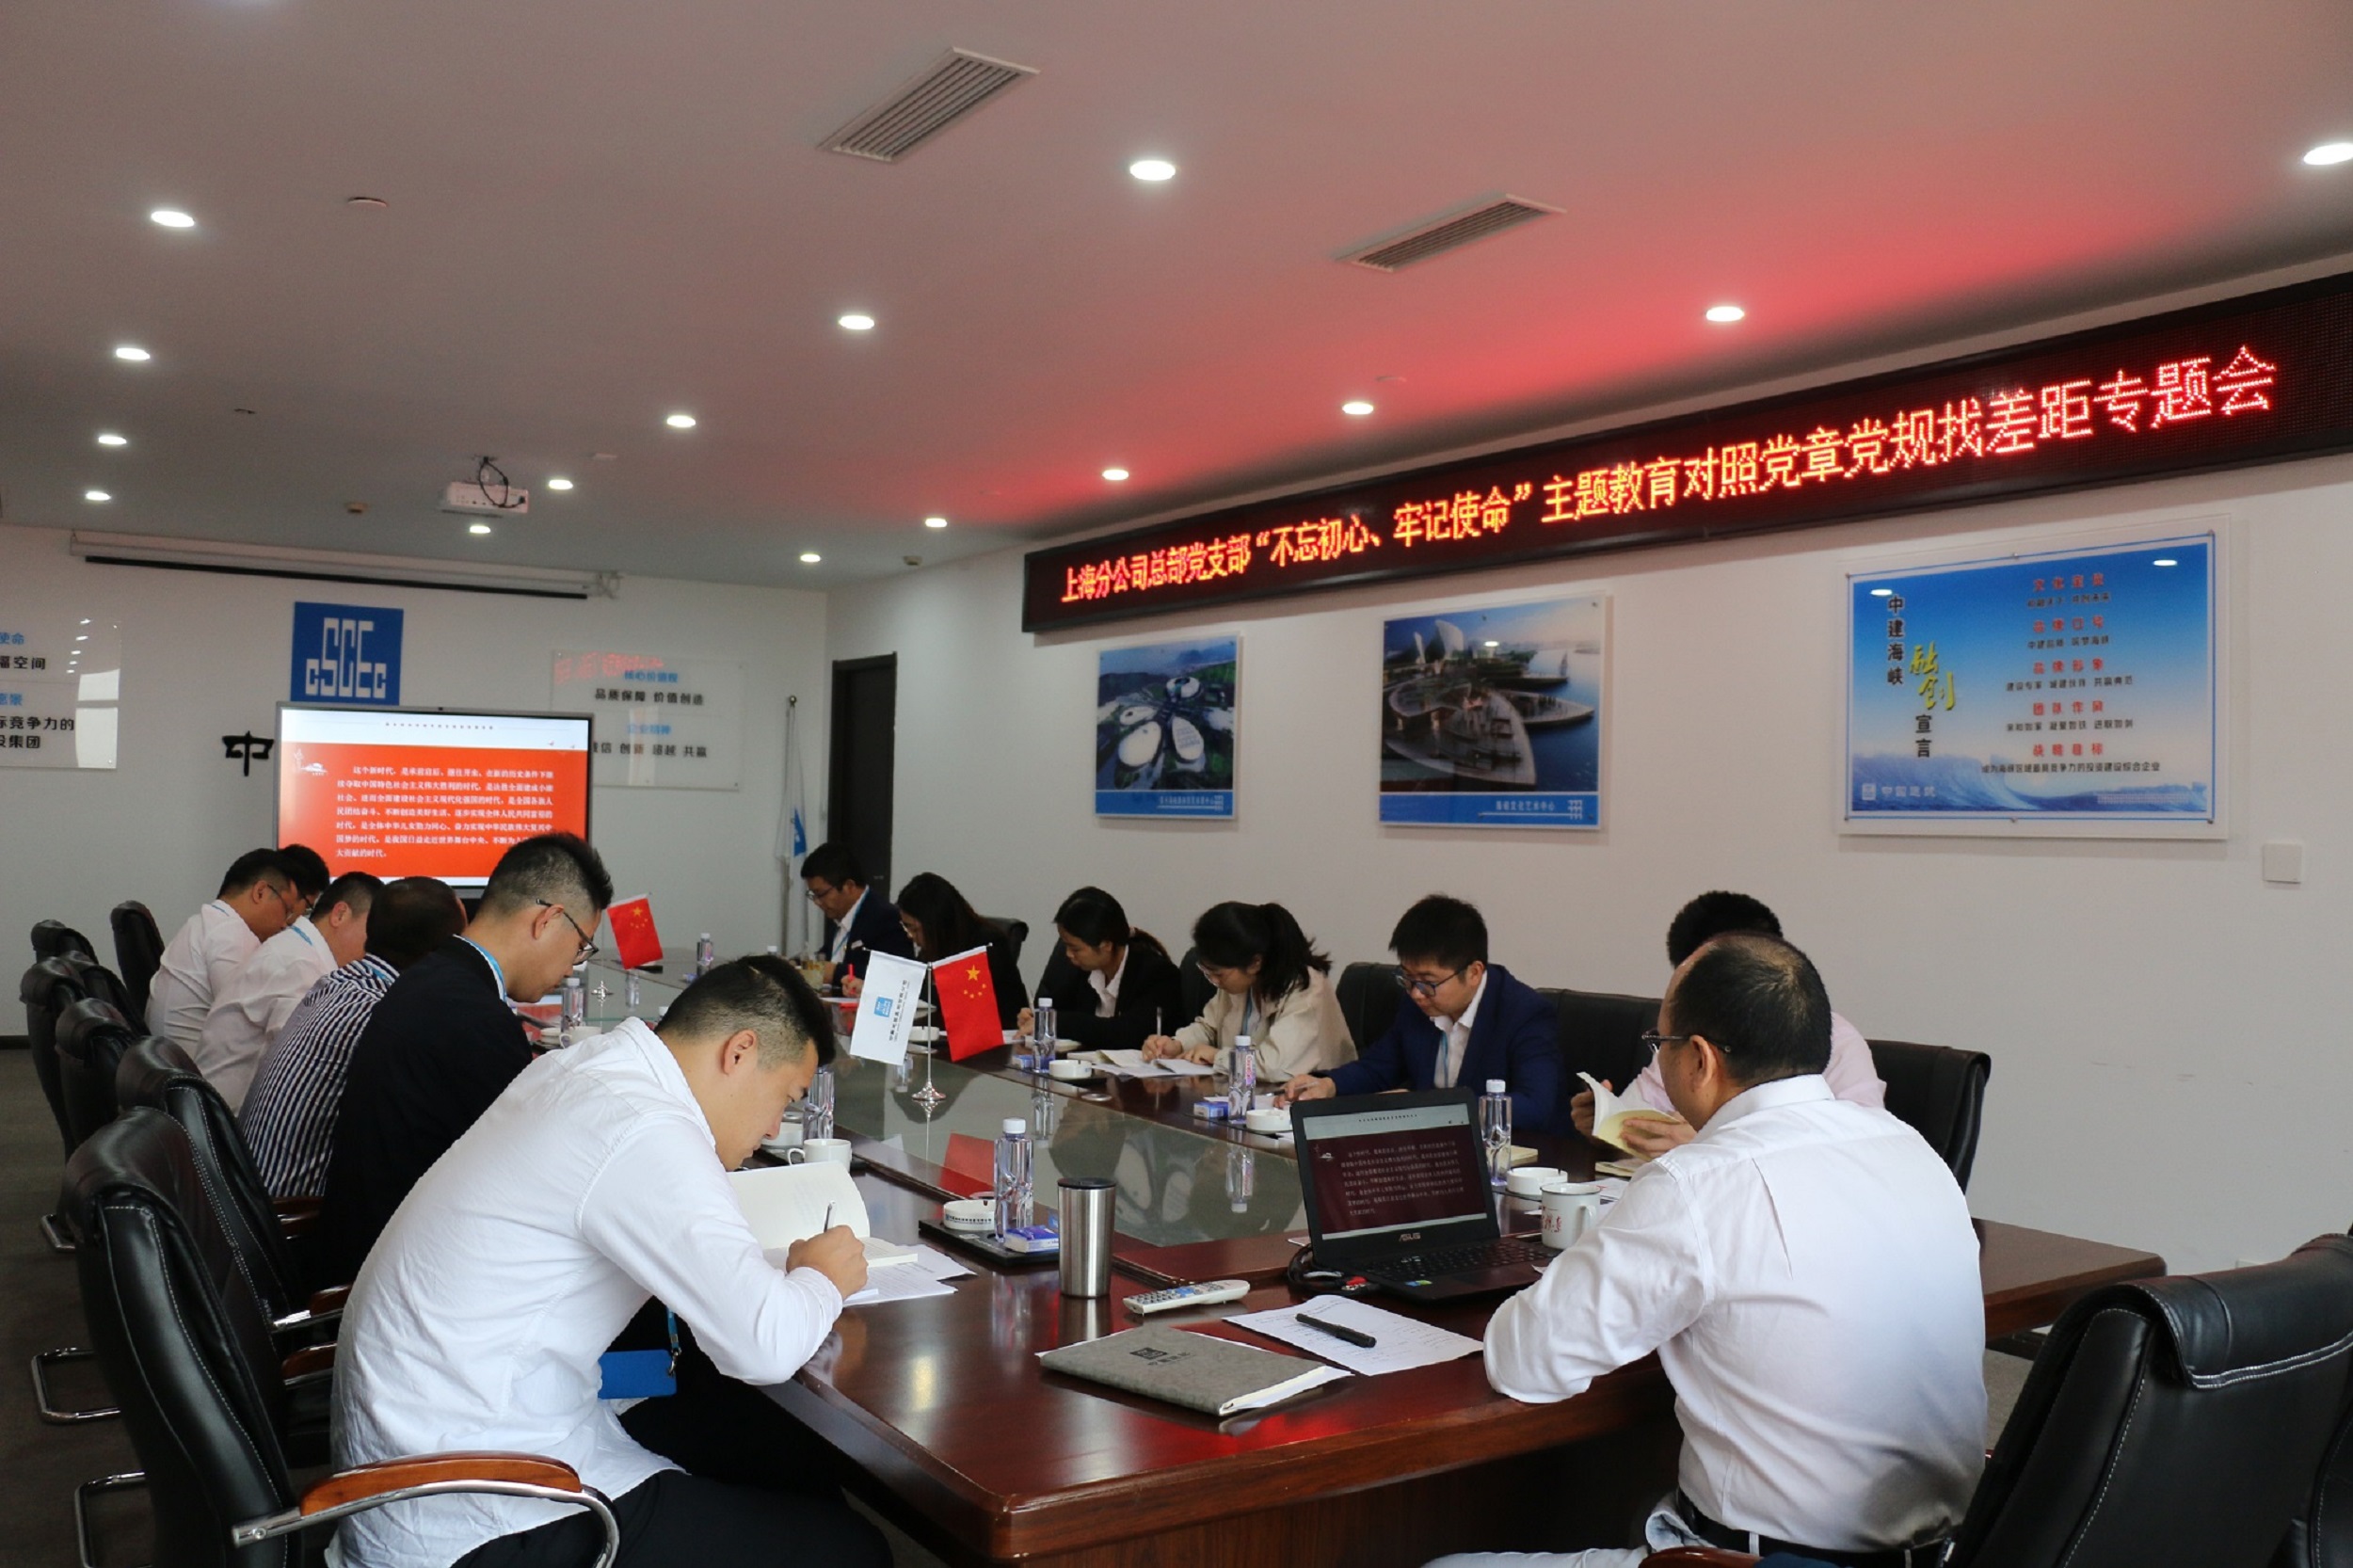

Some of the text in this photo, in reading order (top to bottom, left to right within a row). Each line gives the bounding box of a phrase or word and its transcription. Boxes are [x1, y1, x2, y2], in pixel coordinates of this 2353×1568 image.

[1887, 595, 1904, 686] 中建海峡
[595, 688, 704, 706] 品质保障 价值创造
[222, 730, 275, 777] 中
[1915, 714, 1932, 758] 宣言
